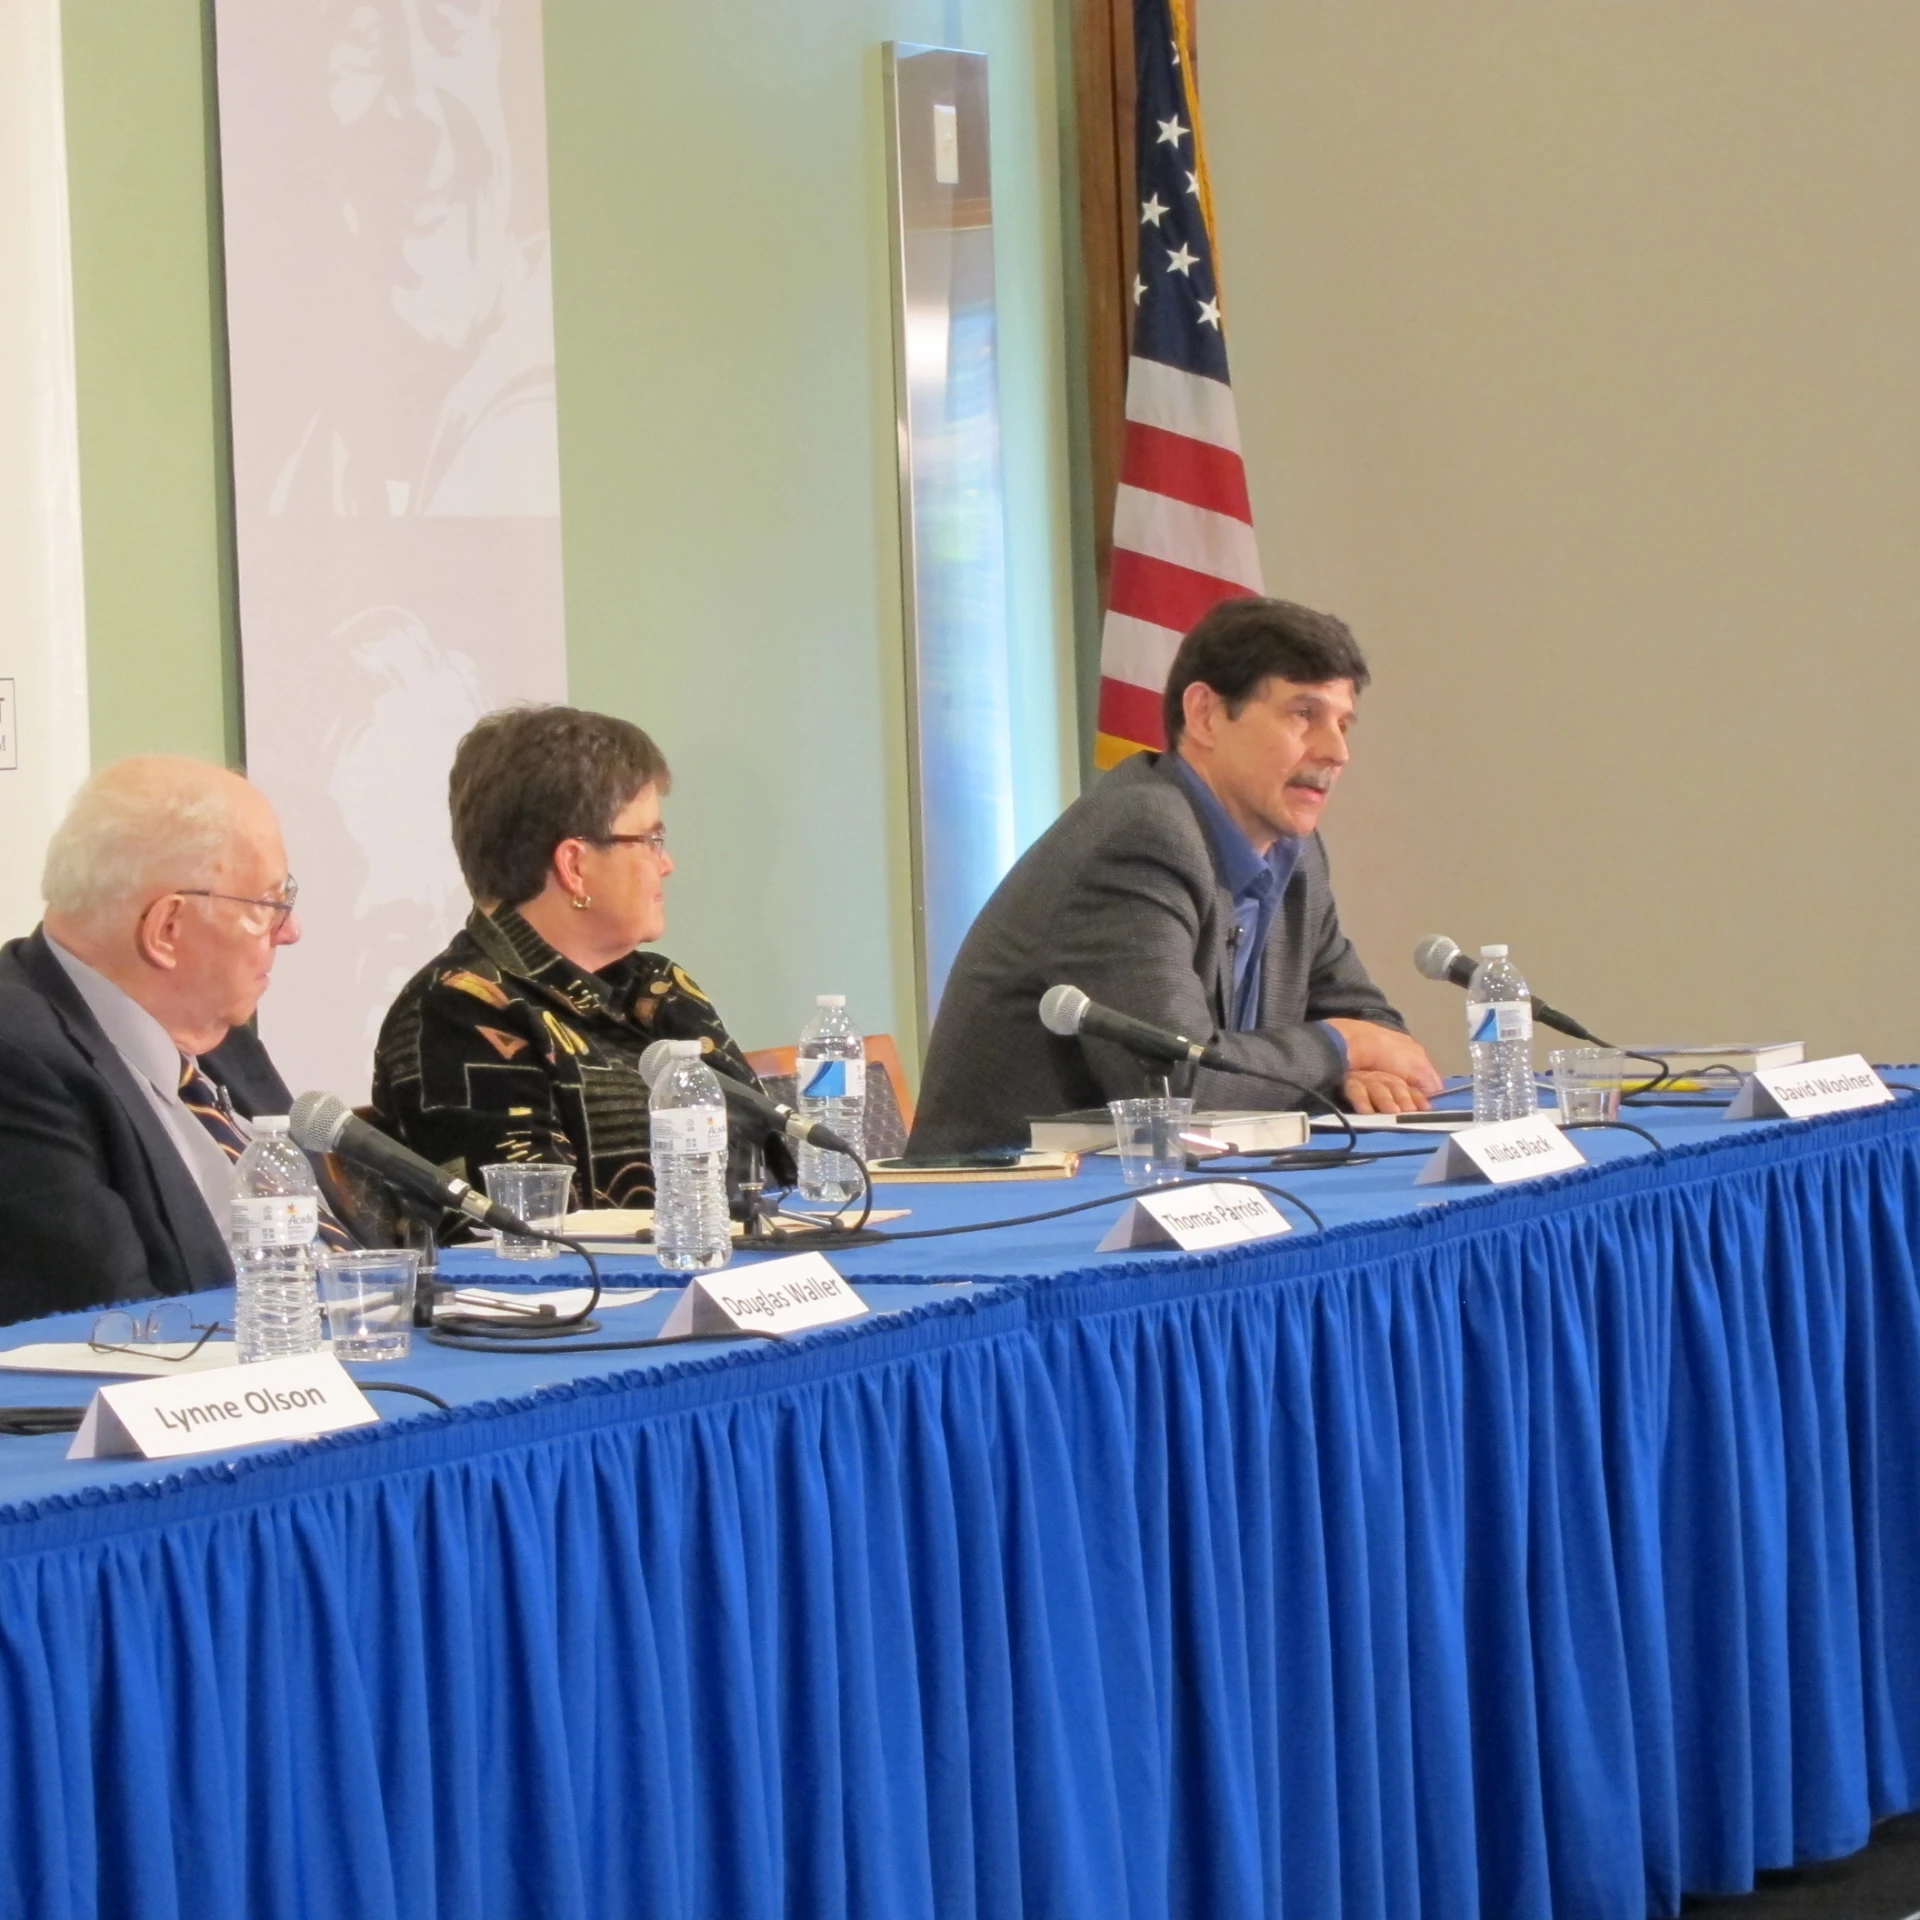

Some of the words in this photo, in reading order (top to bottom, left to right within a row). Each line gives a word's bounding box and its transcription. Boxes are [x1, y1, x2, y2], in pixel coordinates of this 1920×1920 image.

[1773, 1080, 1817, 1101] David
[1812, 1074, 1874, 1095] Woolner
[1484, 1143, 1522, 1163] Allida
[1516, 1135, 1555, 1156] Black
[1161, 1211, 1221, 1232] Thomas
[1214, 1197, 1268, 1222] Parrish
[721, 1288, 791, 1317] Douglas
[782, 1277, 842, 1304] Waller
[154, 1401, 242, 1433] Lynne
[244, 1387, 327, 1415] Olson
